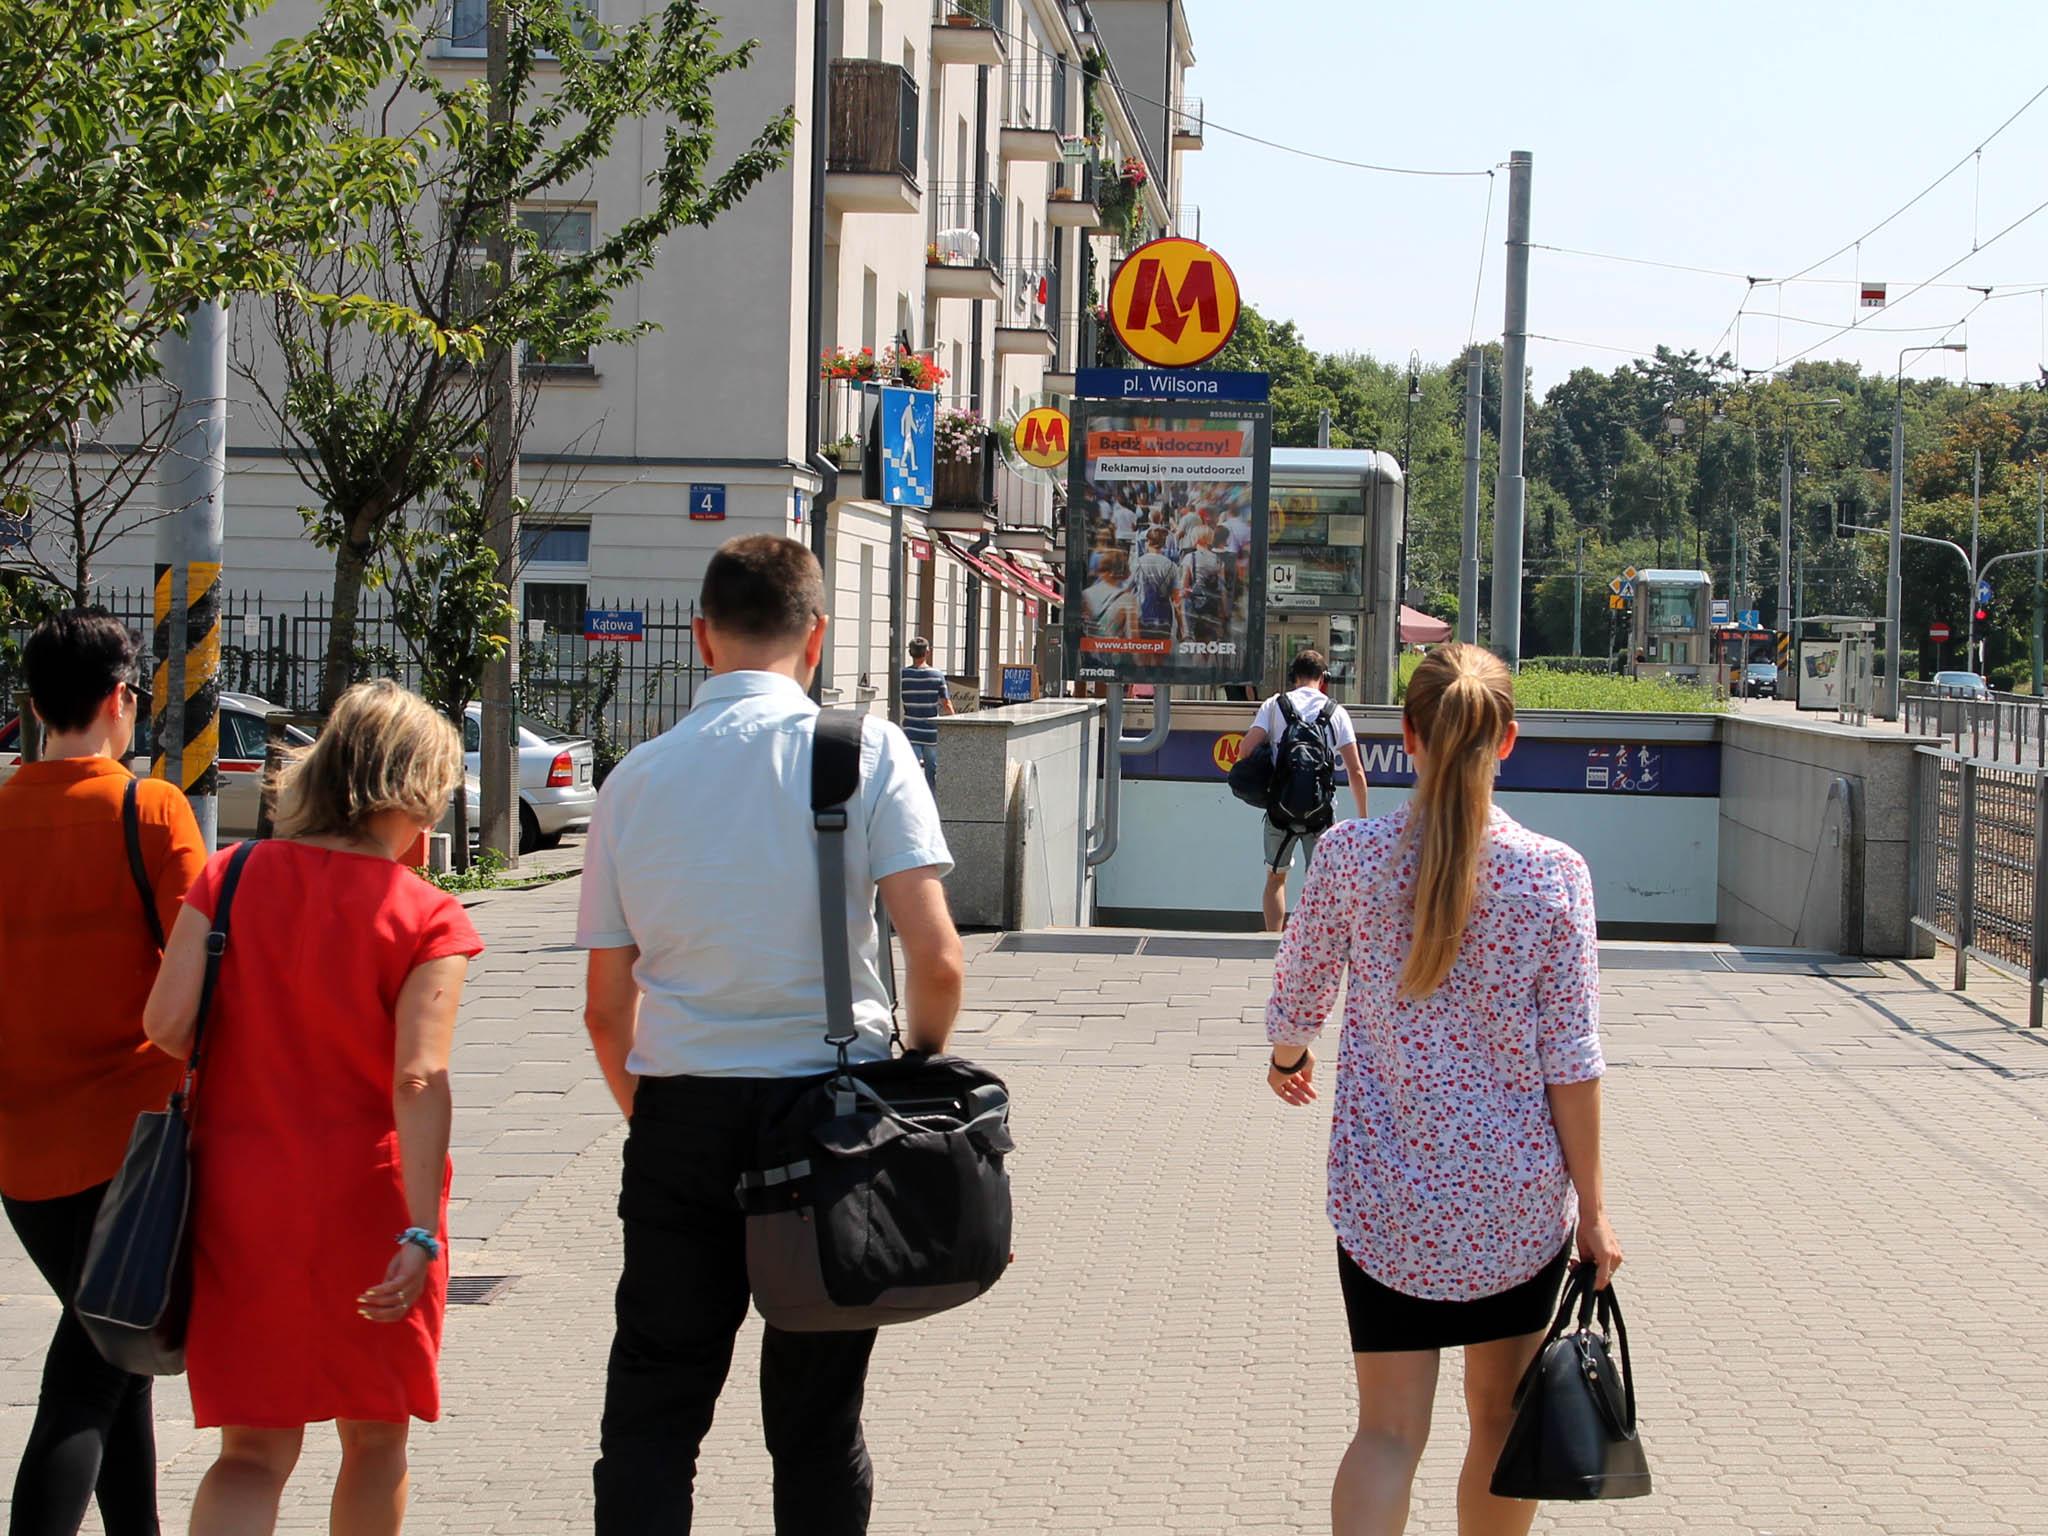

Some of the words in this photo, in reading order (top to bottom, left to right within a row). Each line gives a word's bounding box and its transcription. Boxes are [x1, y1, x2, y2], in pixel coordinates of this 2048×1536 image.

[1126, 259, 1220, 345] M
[1124, 376, 1143, 395] pl.
[1150, 376, 1218, 393] Wilsona
[1023, 418, 1066, 456] M
[1100, 436, 1140, 452] Bądź
[1145, 437, 1229, 455] widoczny!
[1101, 463, 1150, 475] Reklamuj
[1152, 464, 1167, 476] się
[1171, 466, 1184, 474] na
[1186, 465, 1245, 475] outdoorze!
[701, 493, 713, 512] 4
[592, 618, 634, 633] Kątowa
[1095, 641, 1164, 653] www.stroer.pl
